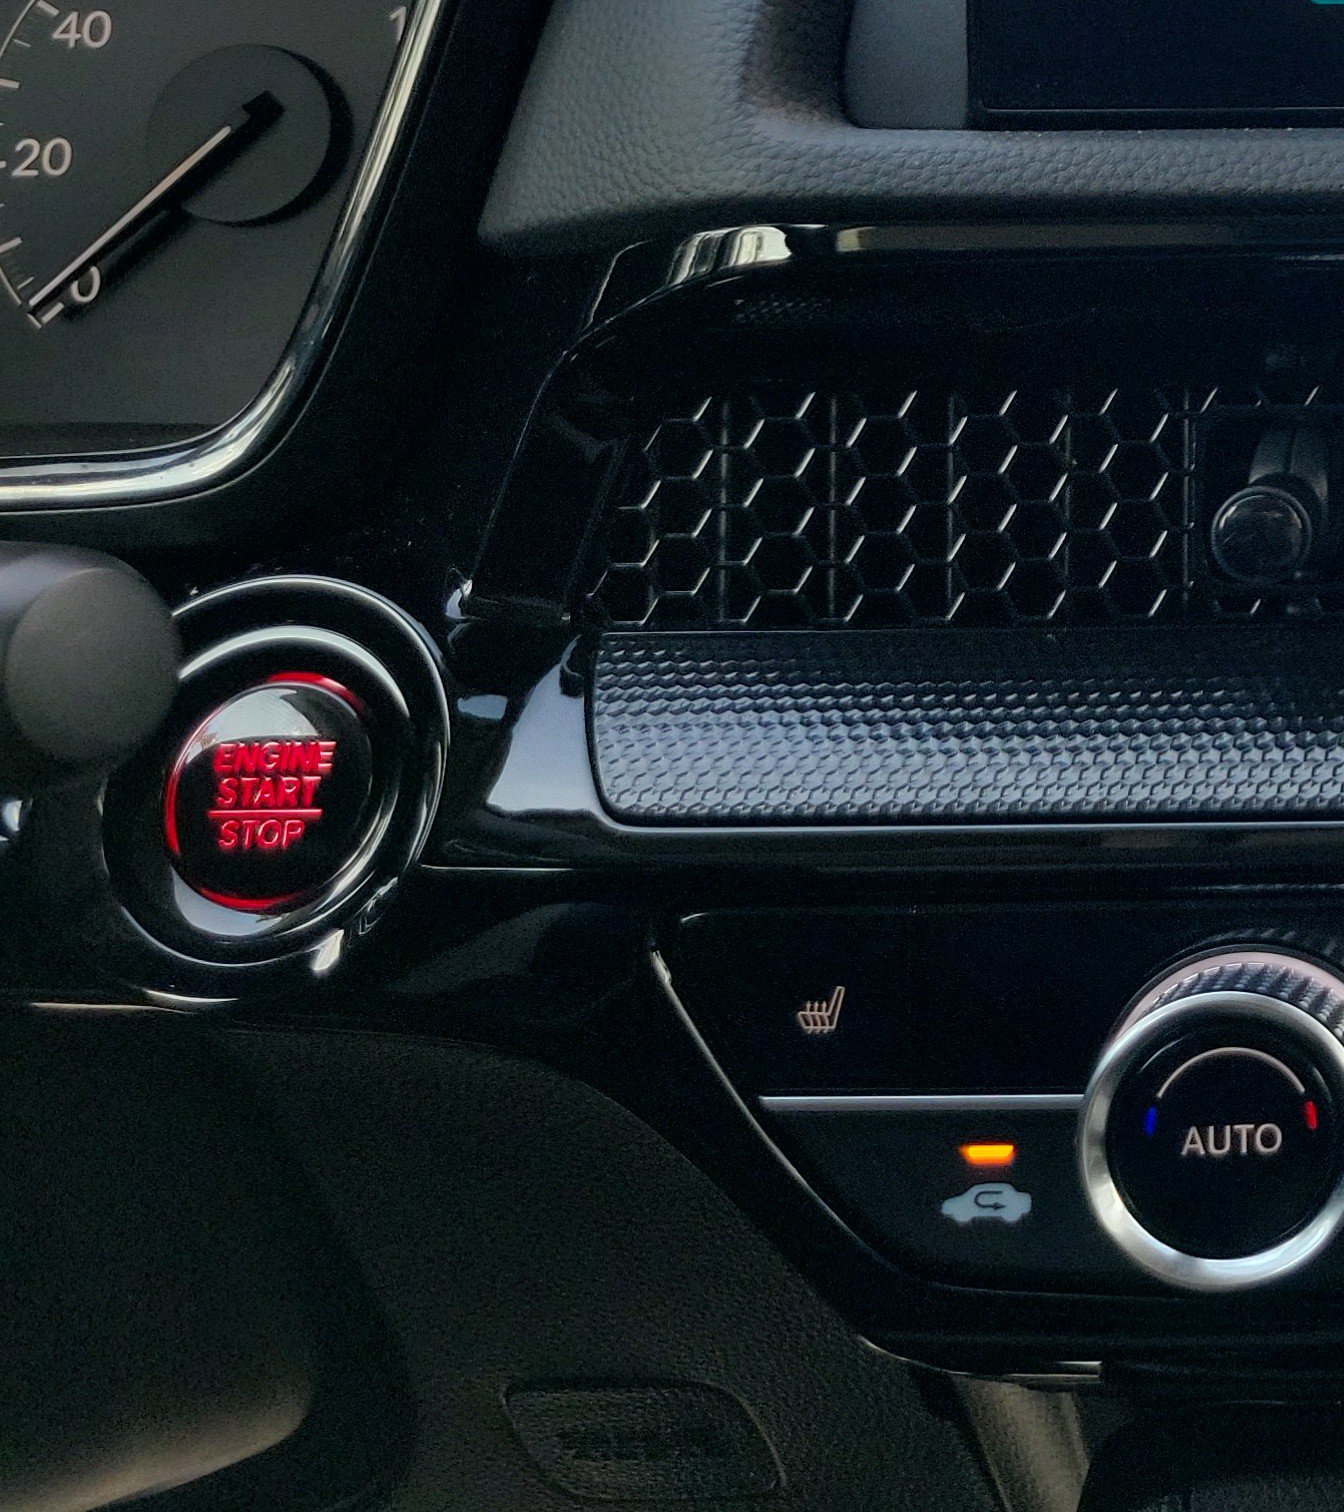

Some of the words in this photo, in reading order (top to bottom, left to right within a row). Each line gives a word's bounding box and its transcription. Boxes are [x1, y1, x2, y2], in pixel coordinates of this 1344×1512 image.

[52, 10, 112, 48] 40
[11, 138, 72, 177] 20
[70, 266, 101, 304] 0
[214, 741, 336, 772] ENGINE
[215, 775, 321, 808] START
[219, 819, 305, 848] STOP
[1181, 1123, 1283, 1157] AUTO
